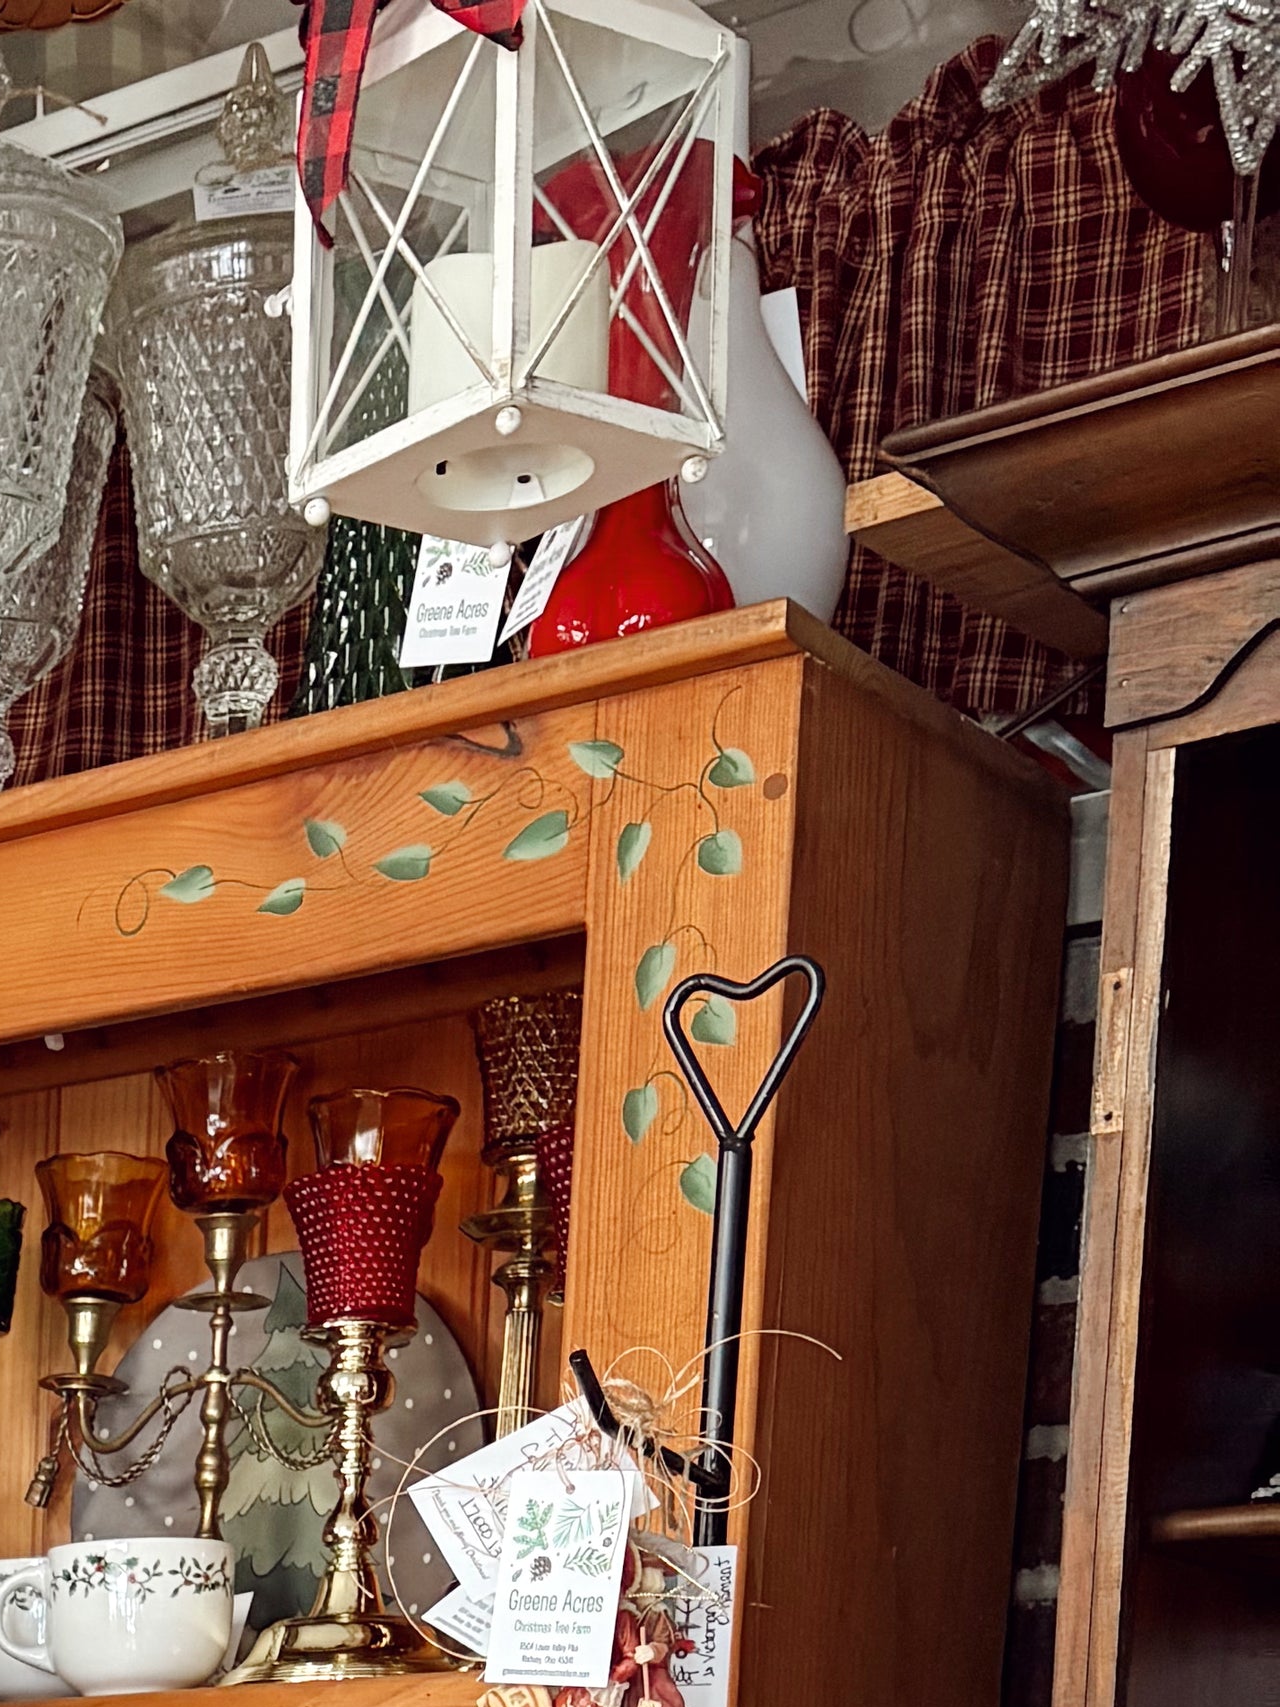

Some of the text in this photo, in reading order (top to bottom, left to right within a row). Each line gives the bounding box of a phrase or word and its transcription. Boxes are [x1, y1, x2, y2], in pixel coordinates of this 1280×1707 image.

[416, 599, 490, 623] Greene Acres
[508, 1588, 604, 1613] Greene Acres
[514, 1619, 591, 1635] Christmas Tree Farm
